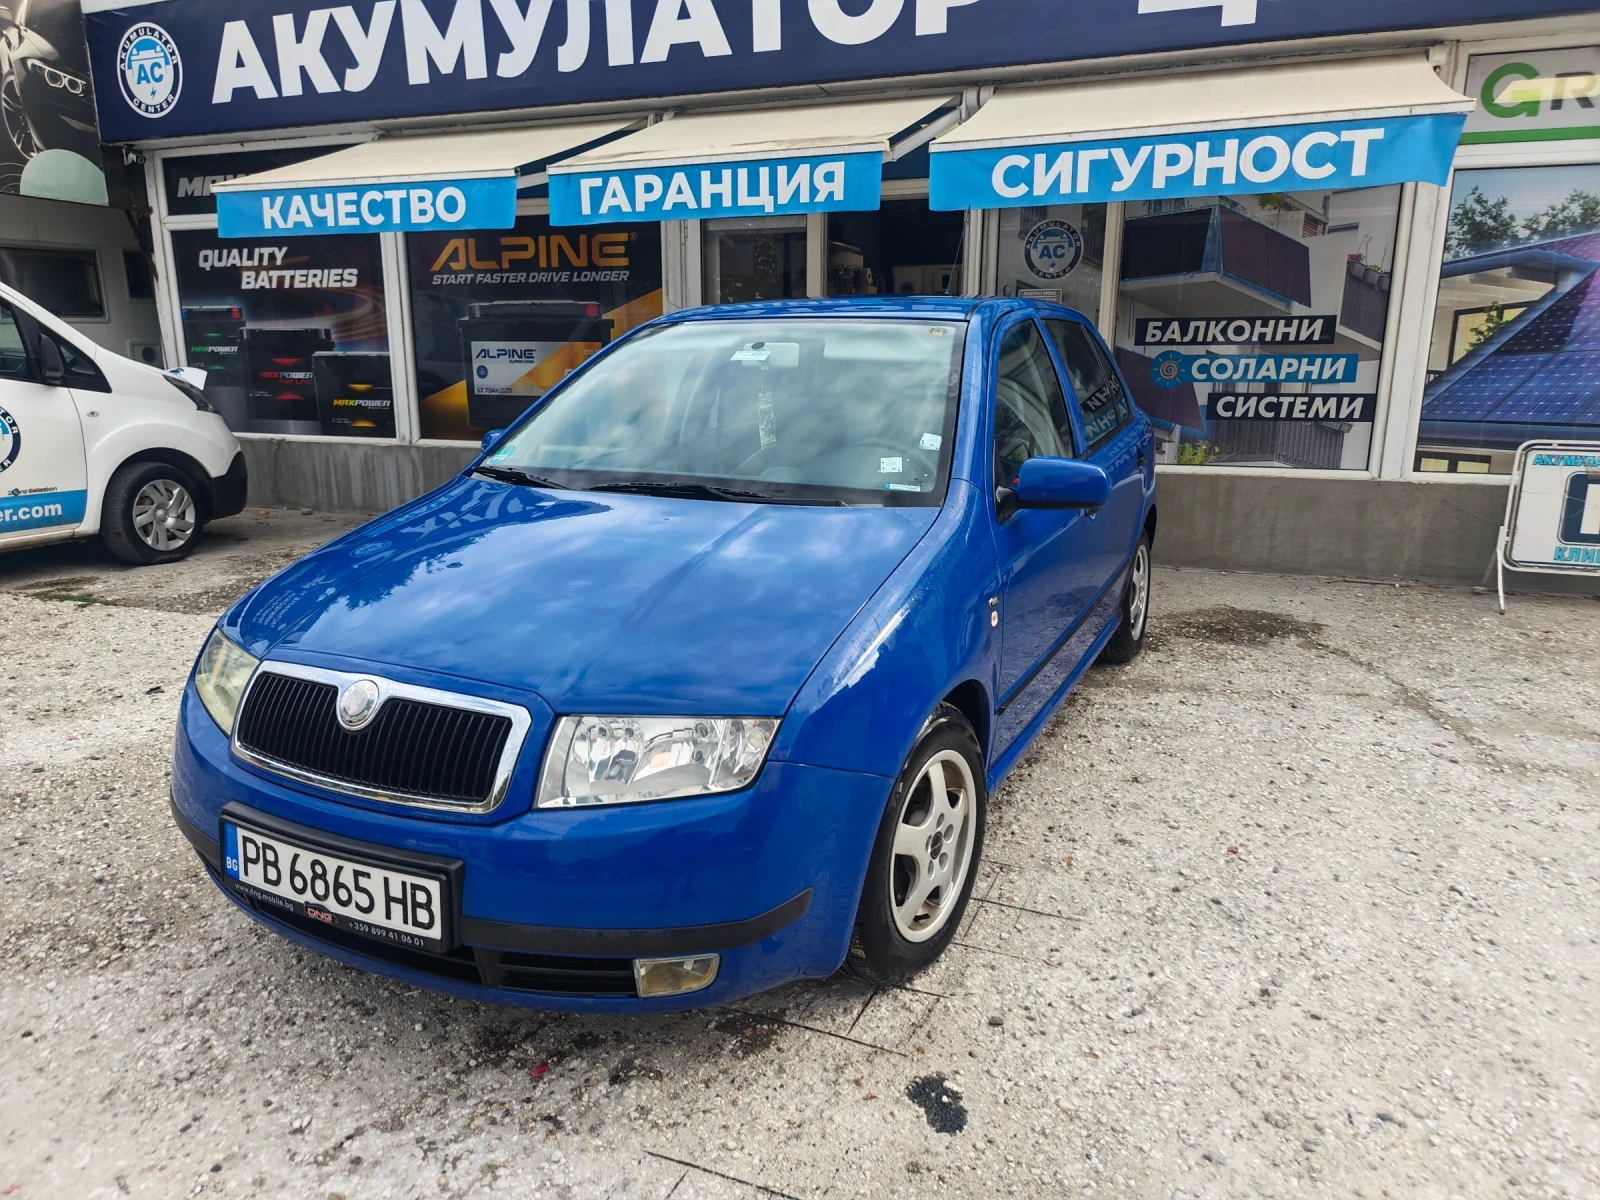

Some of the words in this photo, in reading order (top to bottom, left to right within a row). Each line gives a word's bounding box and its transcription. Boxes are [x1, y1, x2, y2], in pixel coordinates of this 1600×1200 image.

[120, 27, 178, 71] AKUMULATOR
[136, 62, 164, 85] AC
[133, 93, 175, 113] CENTER
[991, 127, 1385, 198] СИГУРНОСТ
[580, 161, 845, 215] ГАРАНЦИЯ
[262, 187, 467, 229] КАЧЕСТВО
[1026, 221, 1081, 250] AKUMULATOR
[198, 246, 288, 271] QUALITY
[1039, 244, 1066, 259] AC
[241, 268, 359, 290] BATTERIES
[432, 273, 475, 285] START
[527, 271, 570, 283] DRIVE
[572, 270, 630, 282] LONGER
[1032, 267, 1072, 280] CENTER
[1145, 317, 1324, 344] БАЛКОННИ
[191, 345, 238, 353] MAXPOWER
[475, 348, 536, 359] ALPINE
[1190, 356, 1348, 381] СОЛАРНИ
[332, 398, 391, 407] MAXPOWER
[1216, 395, 1364, 419] СИСТЕМИ
[226, 856, 238, 872] BG
[289, 852, 375, 915] 6865
[234, 883, 294, 912] www.dng.mobile.bg
[348, 921, 369, 932] +359
[371, 927, 386, 937] 899
[388, 932, 399, 940] 41
[401, 935, 412, 944] 06
[414, 938, 424, 947] 01
